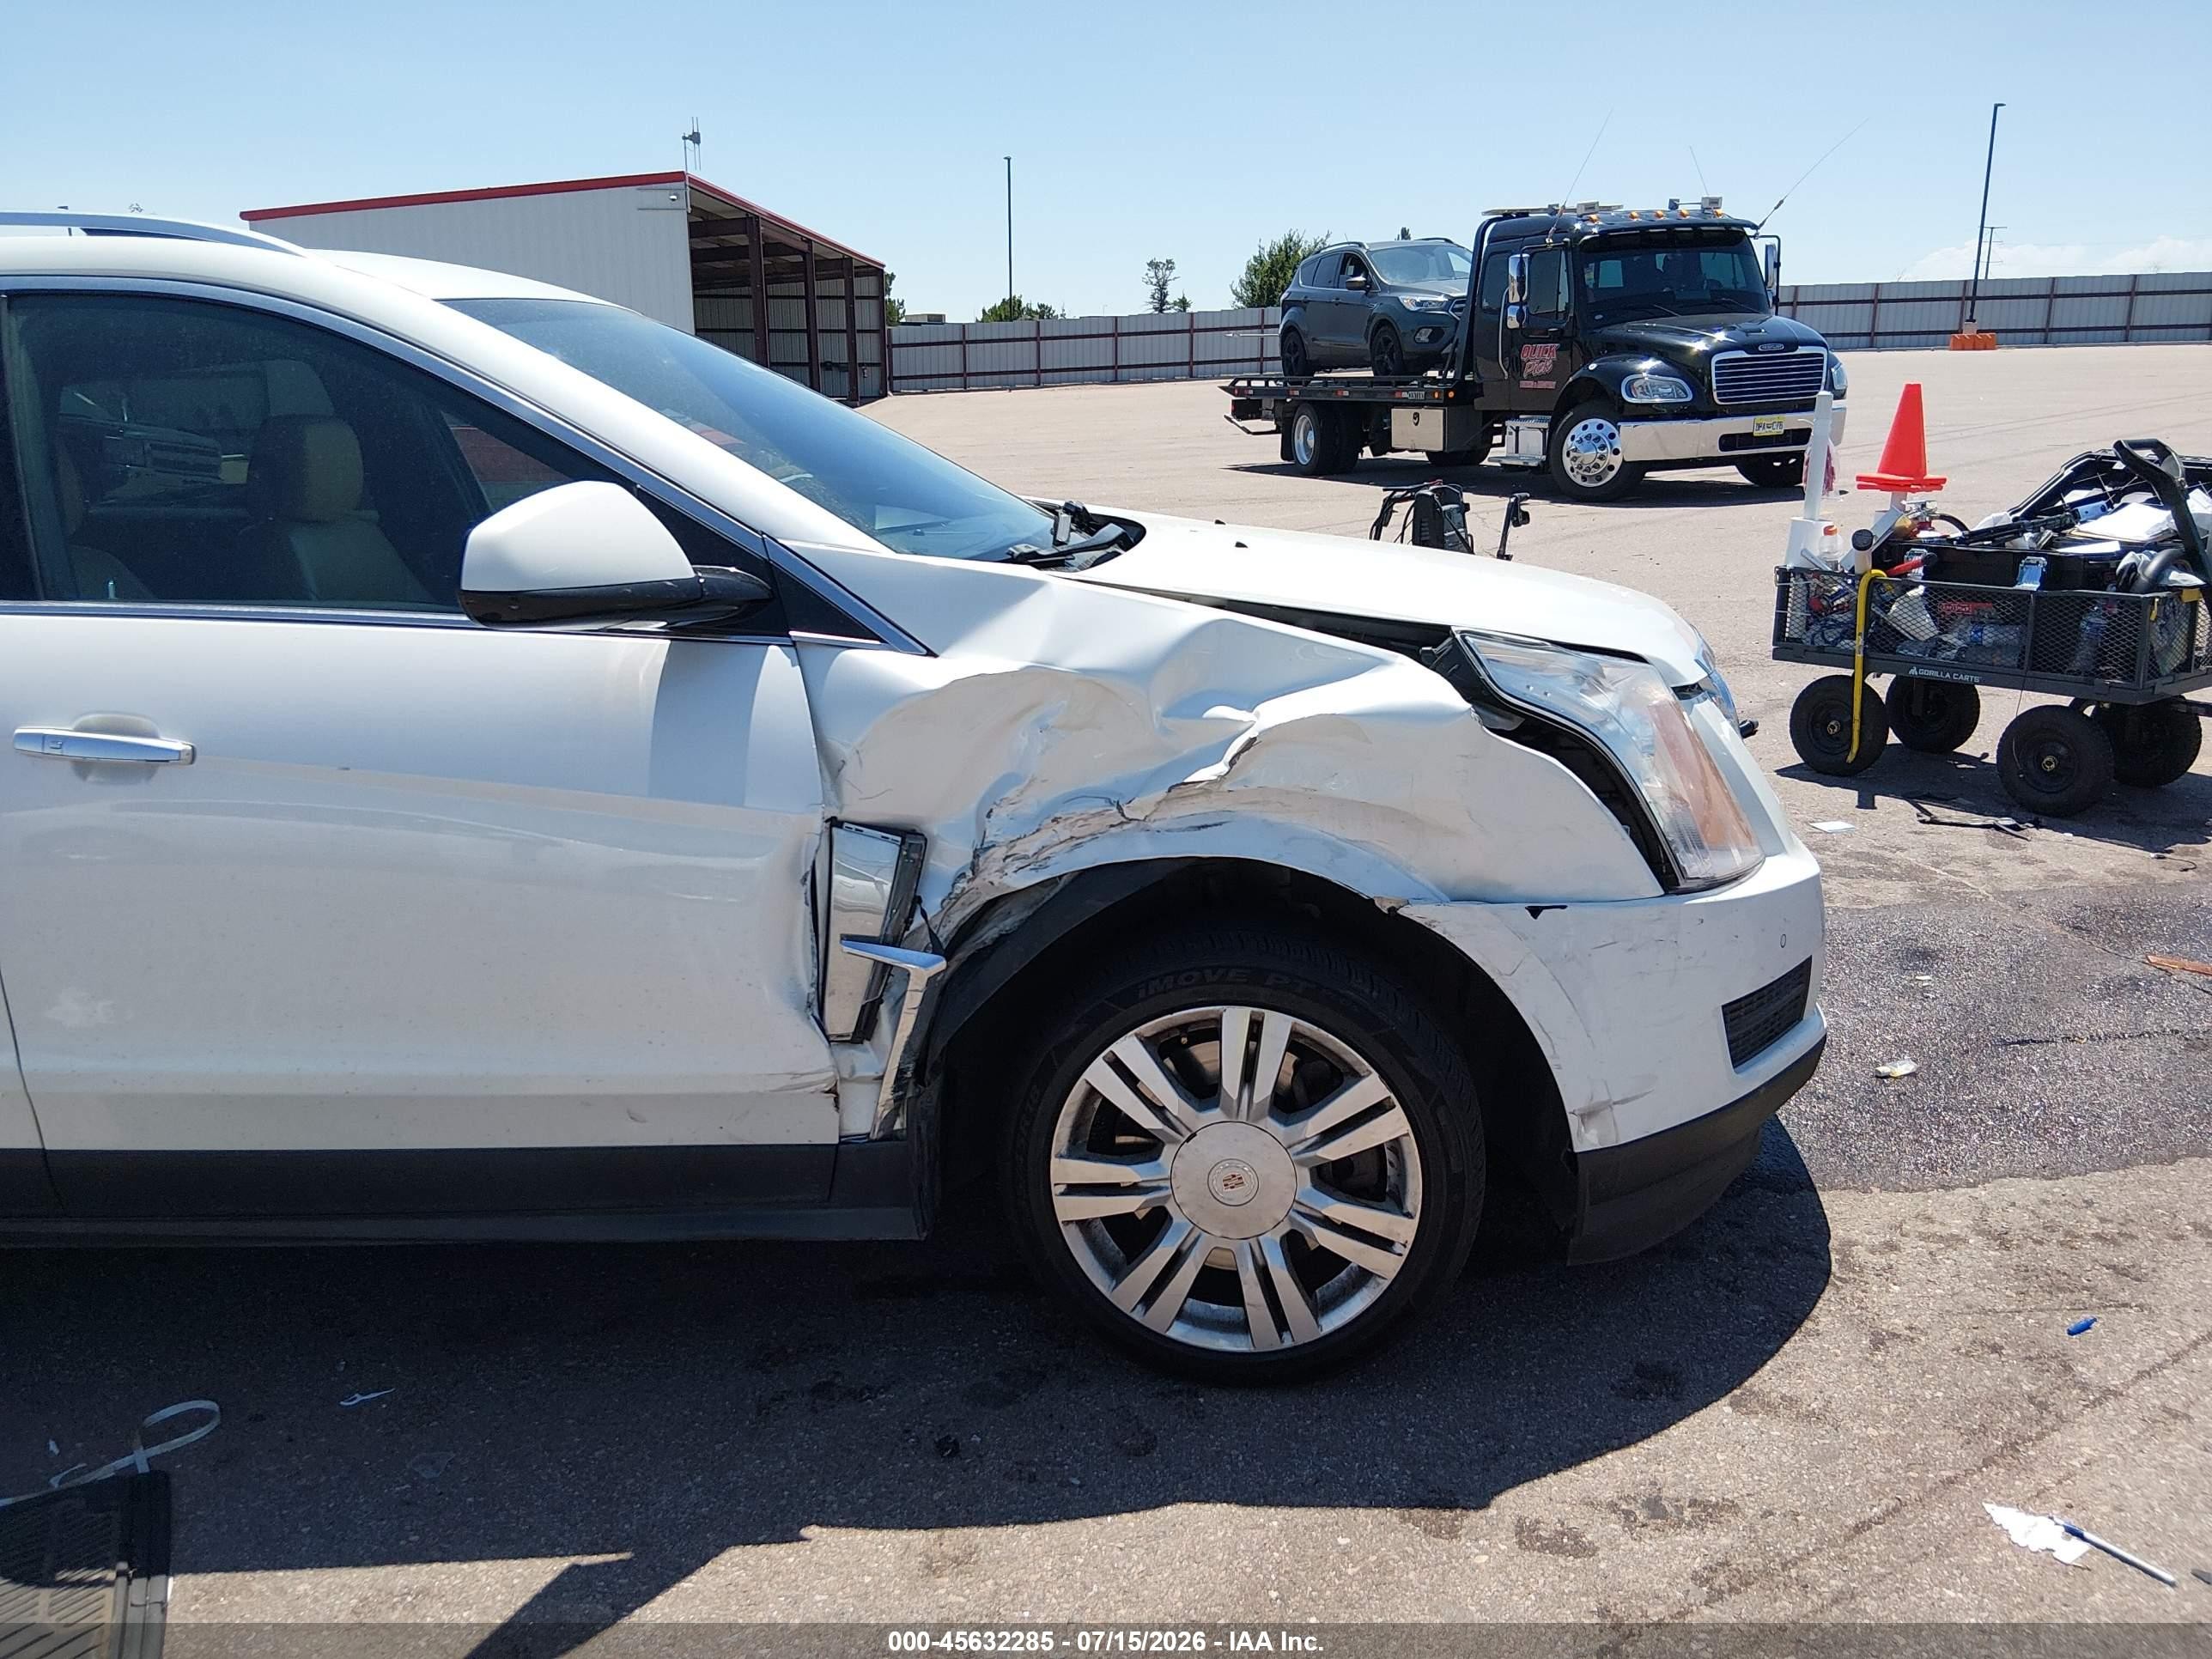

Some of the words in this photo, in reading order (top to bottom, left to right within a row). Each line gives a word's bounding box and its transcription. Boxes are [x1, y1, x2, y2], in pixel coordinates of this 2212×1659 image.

[1521, 343, 1559, 359] QUICK
[1918, 668, 1950, 679] GORILLA
[1953, 672, 1980, 683] CARTS
